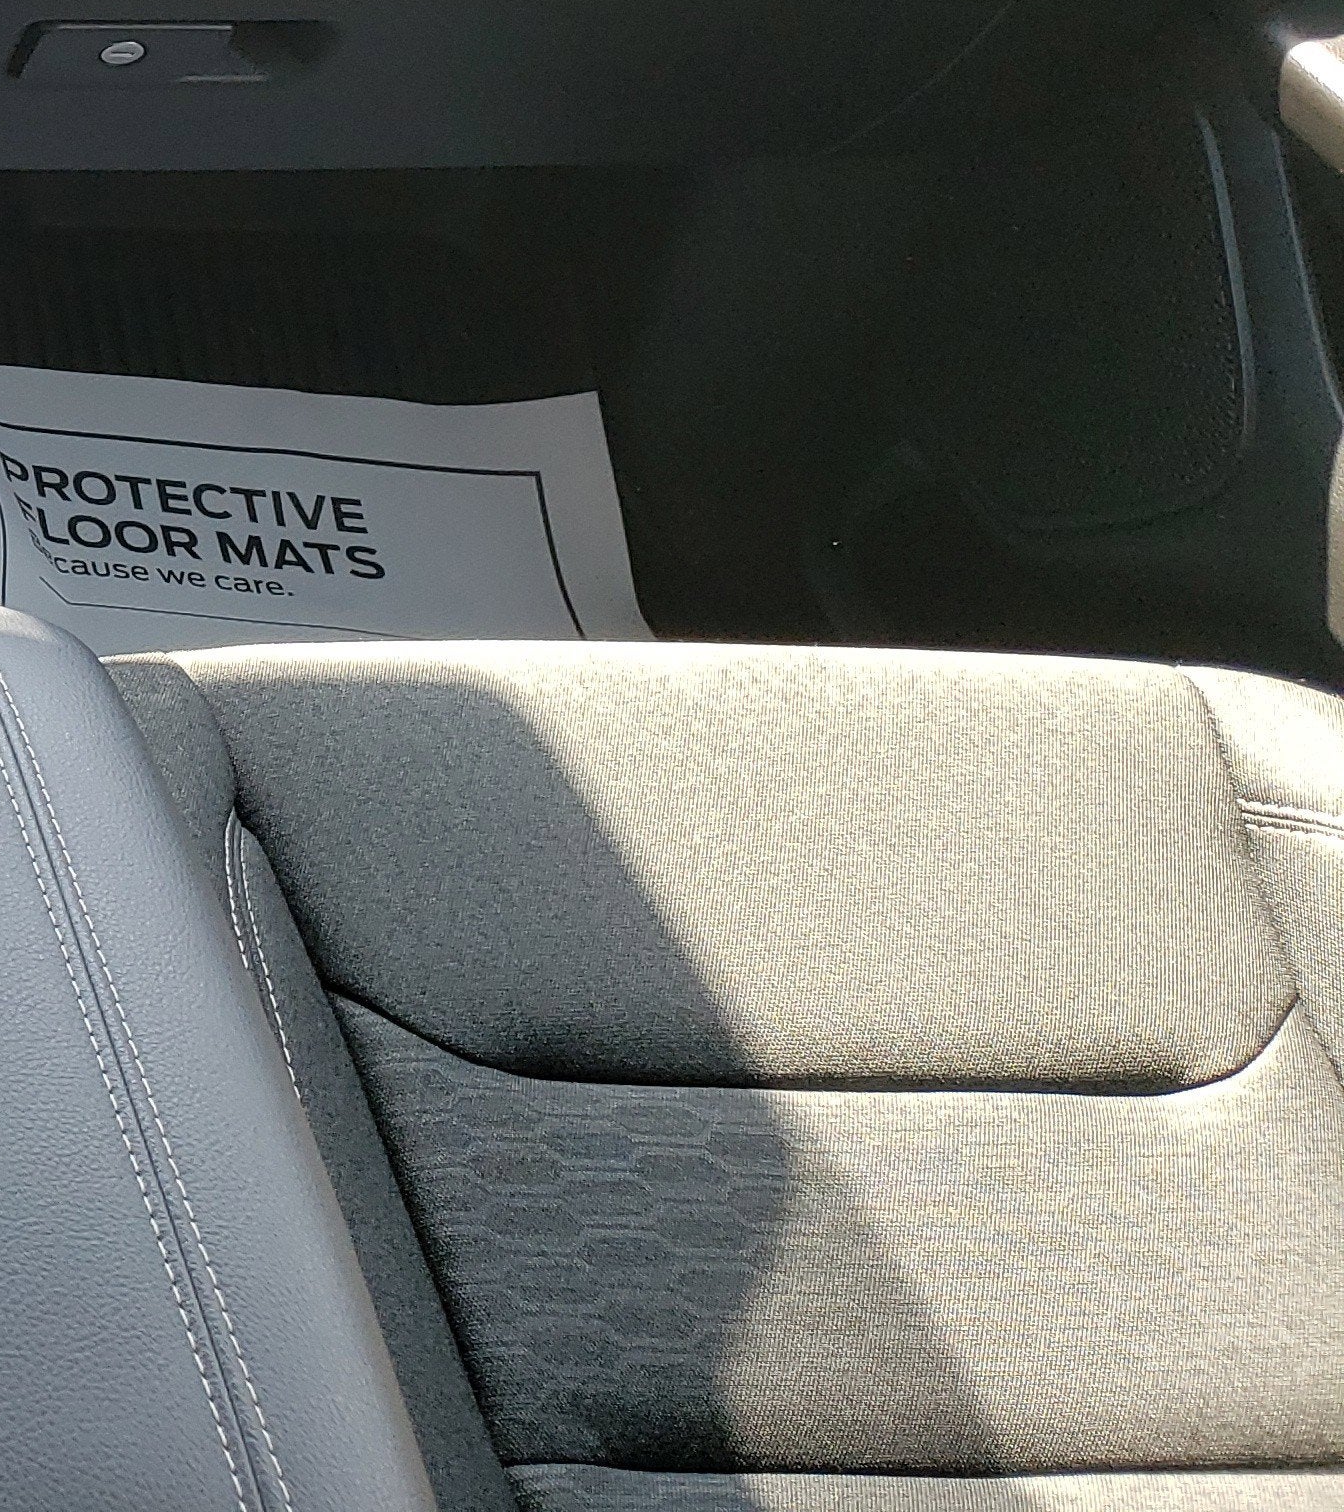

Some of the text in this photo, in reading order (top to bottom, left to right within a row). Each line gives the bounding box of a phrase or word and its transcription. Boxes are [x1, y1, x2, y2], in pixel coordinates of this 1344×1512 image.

[0, 451, 369, 534] PROTECTIVE
[14, 491, 386, 580] FLOOR MATS
[157, 567, 207, 588] we
[214, 574, 295, 598] care.
